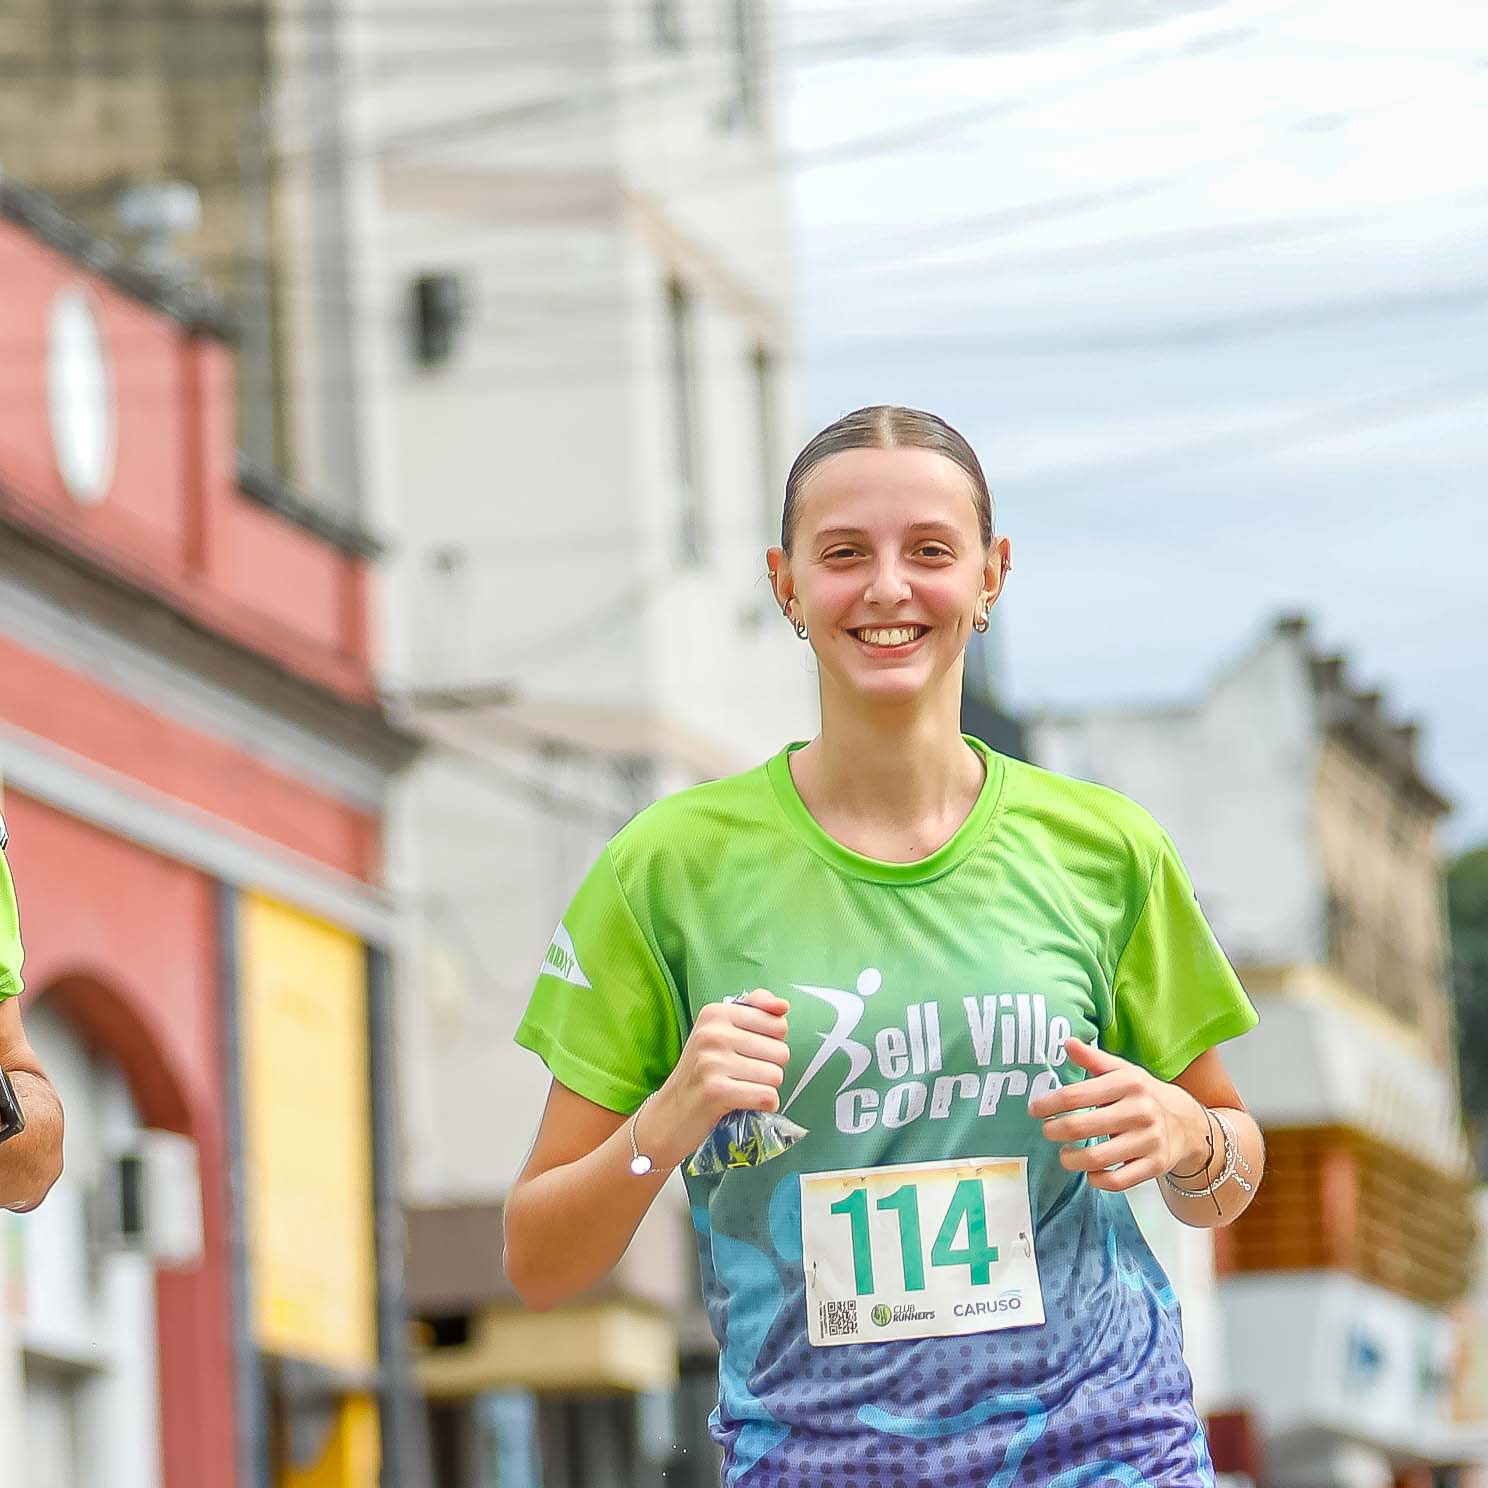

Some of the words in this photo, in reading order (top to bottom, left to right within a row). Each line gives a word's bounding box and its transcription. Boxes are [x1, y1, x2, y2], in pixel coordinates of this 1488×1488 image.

[963, 993, 1072, 1067] Ville
[830, 1179, 999, 1296] 114
[893, 1304, 916, 1314] CLUB
[953, 1297, 1021, 1317] CARUSO
